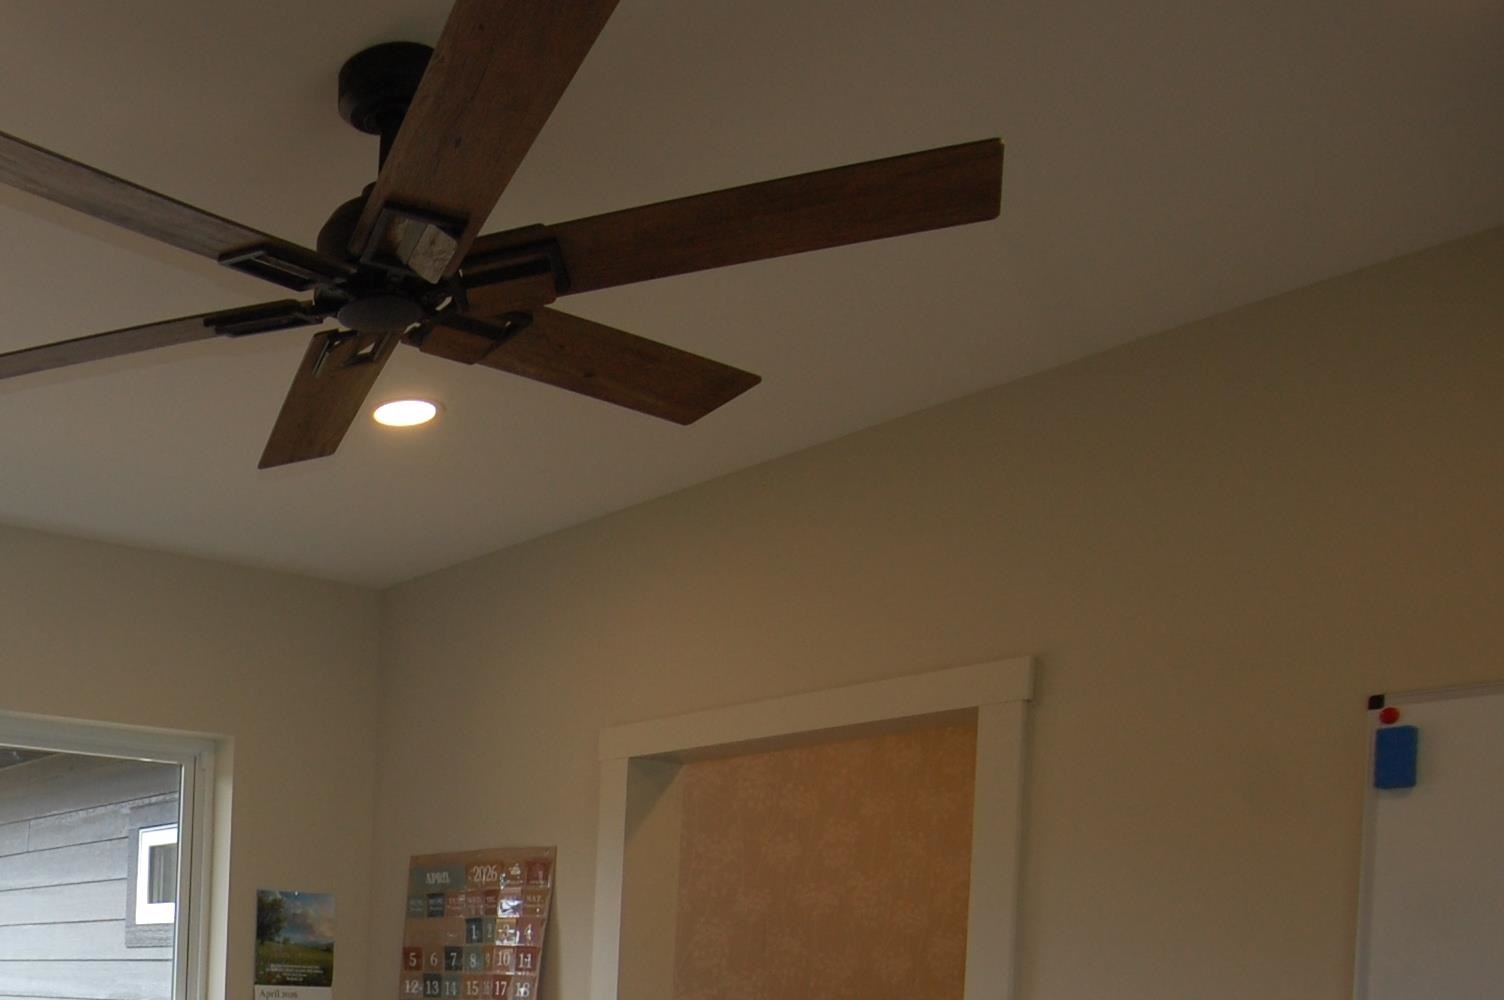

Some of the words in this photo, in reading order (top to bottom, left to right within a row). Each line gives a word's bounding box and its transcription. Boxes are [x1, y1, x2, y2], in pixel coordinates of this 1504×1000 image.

[473, 864, 498, 882] 2026
[471, 924, 478, 939] 1
[409, 952, 417, 967] 5
[430, 952, 438, 966] 6
[450, 952, 457, 966] 7
[469, 953, 477, 967] 8
[496, 950, 511, 966] 10
[518, 952, 532, 969] 11
[260, 988, 280, 1000] April
[404, 979, 418, 993] 12
[425, 979, 439, 995] 13
[444, 981, 457, 996] 14
[466, 980, 479, 996] 15
[495, 979, 508, 996] 17
[514, 981, 531, 998] 18
